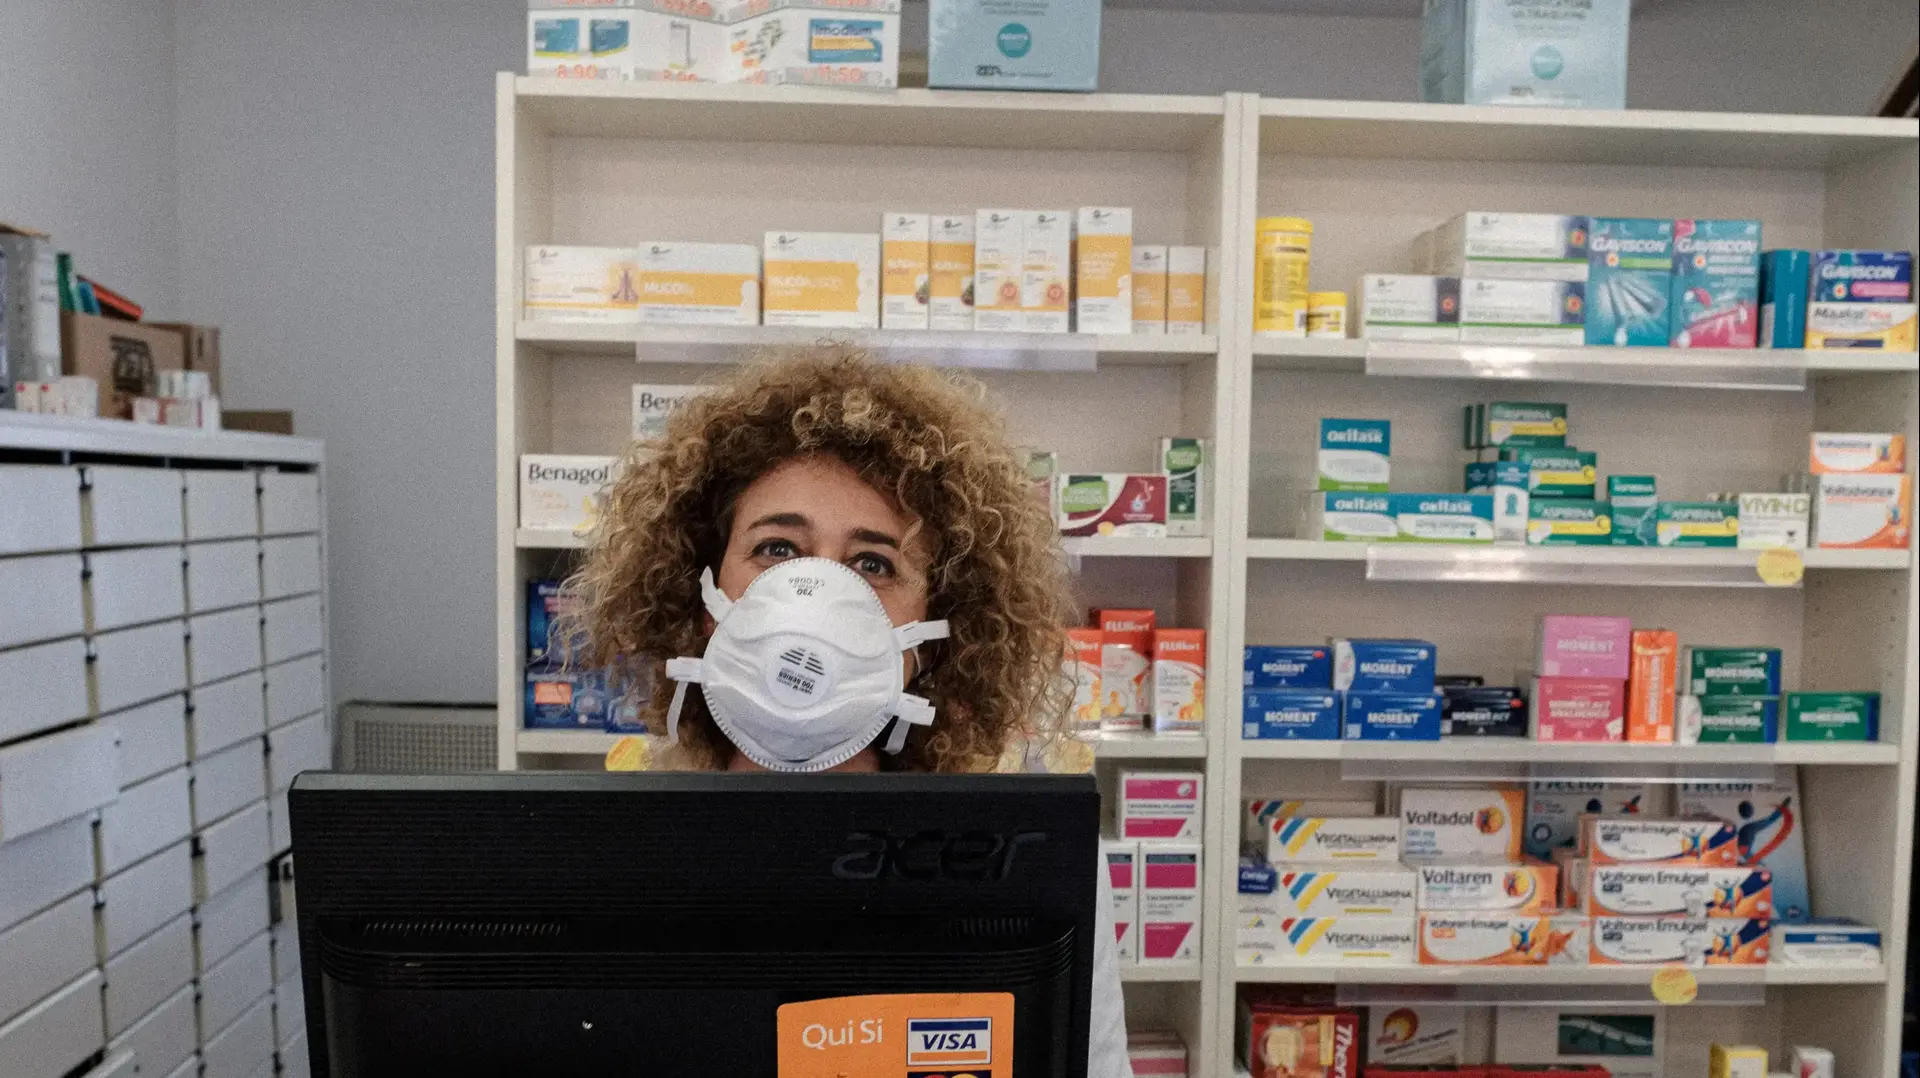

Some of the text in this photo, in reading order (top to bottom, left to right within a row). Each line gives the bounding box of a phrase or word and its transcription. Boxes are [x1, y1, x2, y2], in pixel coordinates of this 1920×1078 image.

[528, 463, 610, 485] Benagol
[1261, 662, 1307, 673] MOMENT
[1360, 662, 1414, 675] MOMENT
[1264, 710, 1318, 723] MOMENT
[1367, 711, 1420, 724] MOMENT
[1405, 810, 1474, 826] Voltadol
[832, 831, 1046, 879] acer
[1422, 868, 1493, 885] Voltaren
[1600, 871, 1709, 886] Voltaren Emulgel
[1600, 919, 1708, 934] Voltaren Emulgel
[801, 1018, 884, 1050] Qui Si
[921, 1033, 977, 1050] VISA
